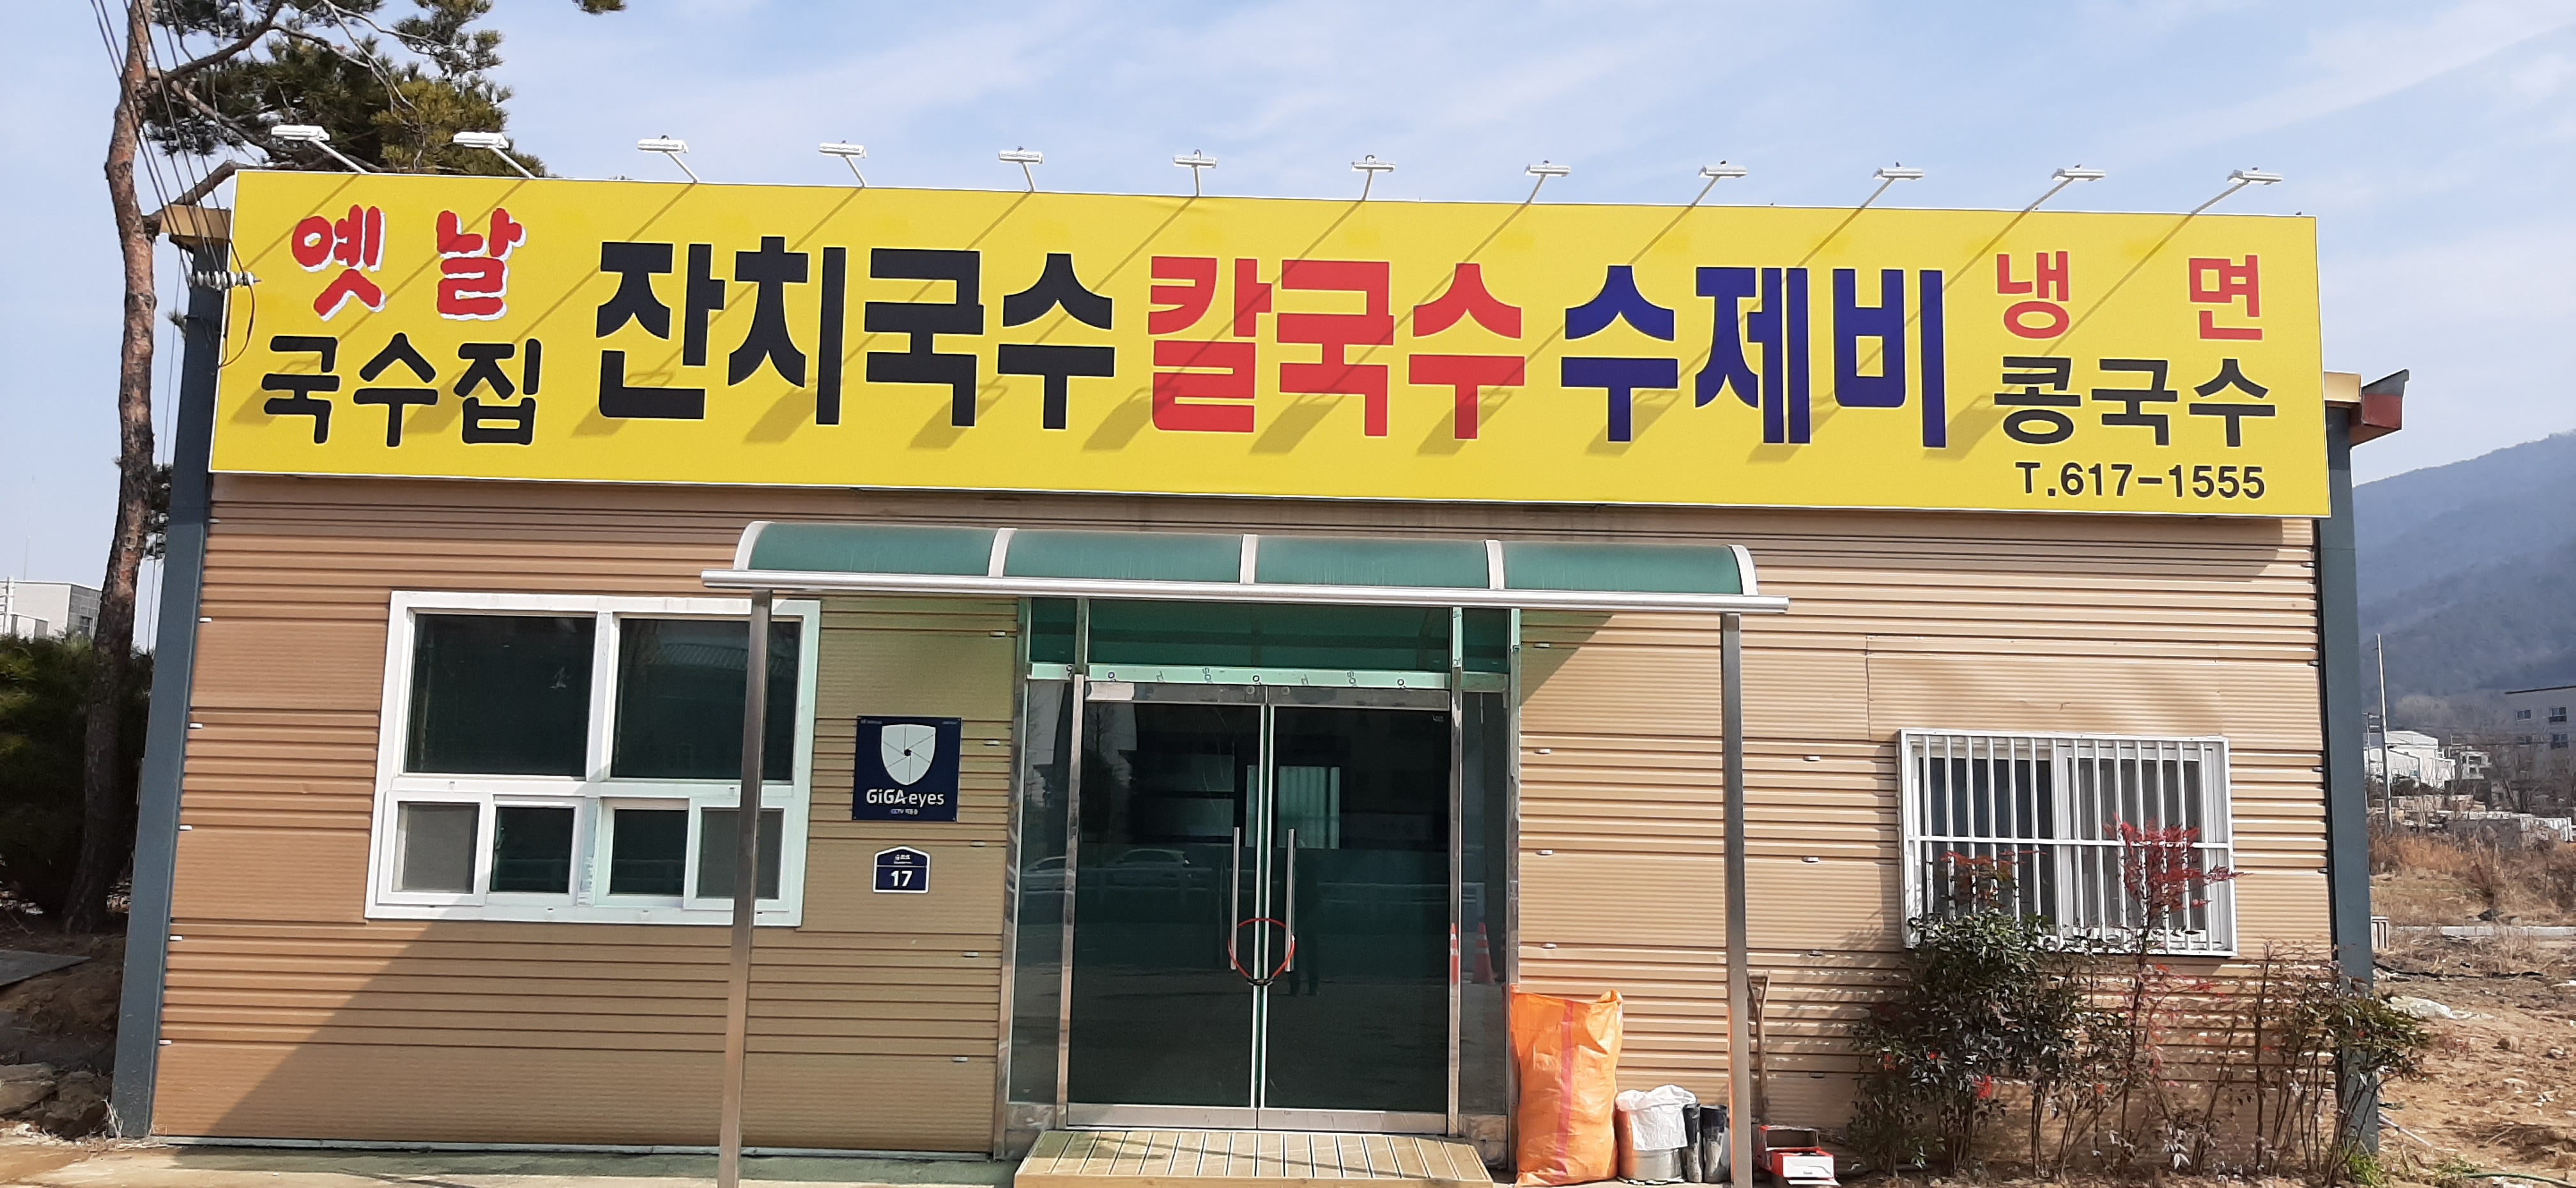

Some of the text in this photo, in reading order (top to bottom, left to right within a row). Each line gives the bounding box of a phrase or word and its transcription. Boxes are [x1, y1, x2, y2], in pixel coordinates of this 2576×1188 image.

[595, 236, 1947, 448] 잔치국수 칼국수 수제비
[261, 331, 542, 447] 국수집
[1993, 355, 2276, 447] 콩국수
[2015, 461, 2266, 499] T.617-1555
[890, 870, 913, 887] 17
